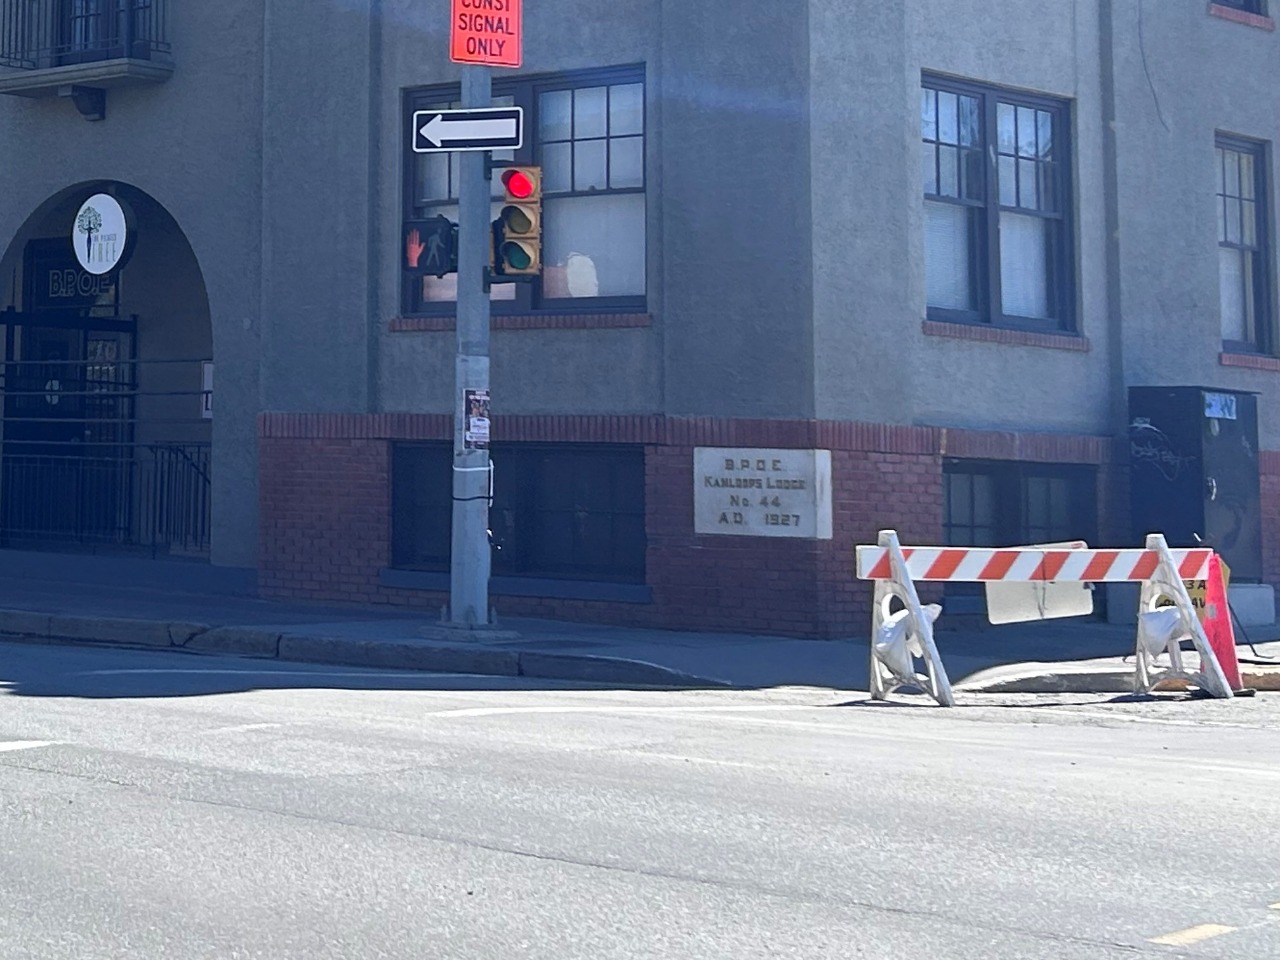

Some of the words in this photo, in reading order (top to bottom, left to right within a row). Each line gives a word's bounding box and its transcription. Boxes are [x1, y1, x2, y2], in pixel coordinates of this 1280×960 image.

[457, 13, 514, 36] SIGNAL
[465, 36, 506, 58] ONLY
[759, 495, 782, 508] 44
[765, 513, 800, 526] 1927
